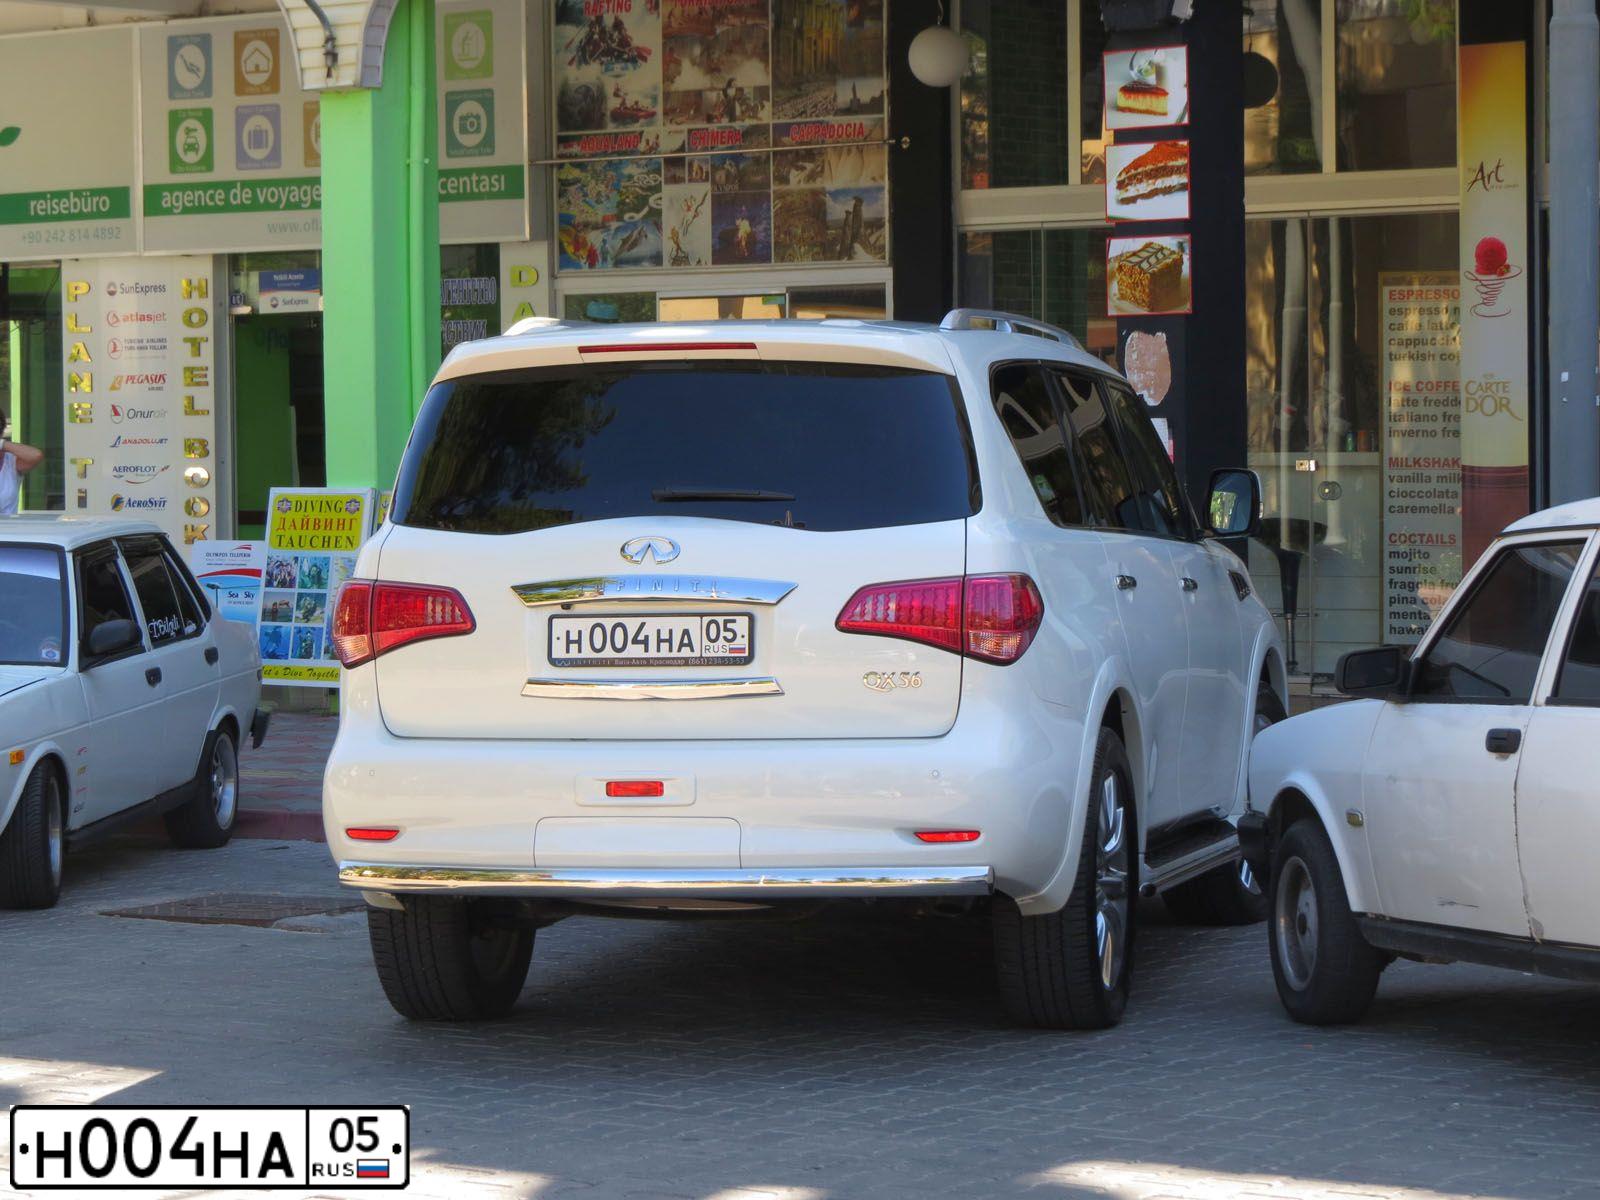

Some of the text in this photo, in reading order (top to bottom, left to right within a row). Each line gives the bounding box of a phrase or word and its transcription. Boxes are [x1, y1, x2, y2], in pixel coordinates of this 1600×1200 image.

[582, 0, 632, 17] RAFTING
[690, 128, 743, 147] CHIMERA
[789, 122, 865, 142] CAPPADOCIA
[1466, 157, 1505, 193] Art
[29, 191, 110, 216] reisebüro
[161, 182, 322, 213] agence de voyage
[119, 282, 167, 296] SunExpress
[1388, 288, 1460, 301] ESPRESSO
[122, 311, 168, 324] atlasjet
[1388, 350, 1436, 362] turkish
[125, 373, 168, 385] PEGASUS
[1388, 380, 1412, 392] ICE
[1465, 380, 1513, 396] CARTE
[1388, 411, 1438, 423] italiano
[1388, 427, 1438, 438] inverno
[112, 465, 157, 473] AEROFLOT
[1388, 472, 1432, 484] vanilla
[1388, 487, 1459, 499] cioccolata
[294, 499, 344, 514] DIVING
[1388, 503, 1455, 515] caremella
[275, 515, 358, 533] ДАЙВИНГ
[276, 534, 356, 550] TAUCHEN
[1388, 533, 1457, 545] COCTAILS
[1388, 548, 1431, 561] mojito
[1388, 565, 1438, 575] sunrise
[1388, 595, 1417, 607] pina
[1388, 610, 1431, 621] menta
[705, 618, 738, 643] 05
[704, 644, 728, 654] RUS
[282, 666, 303, 677] Dive
[306, 667, 339, 680] Togethe
